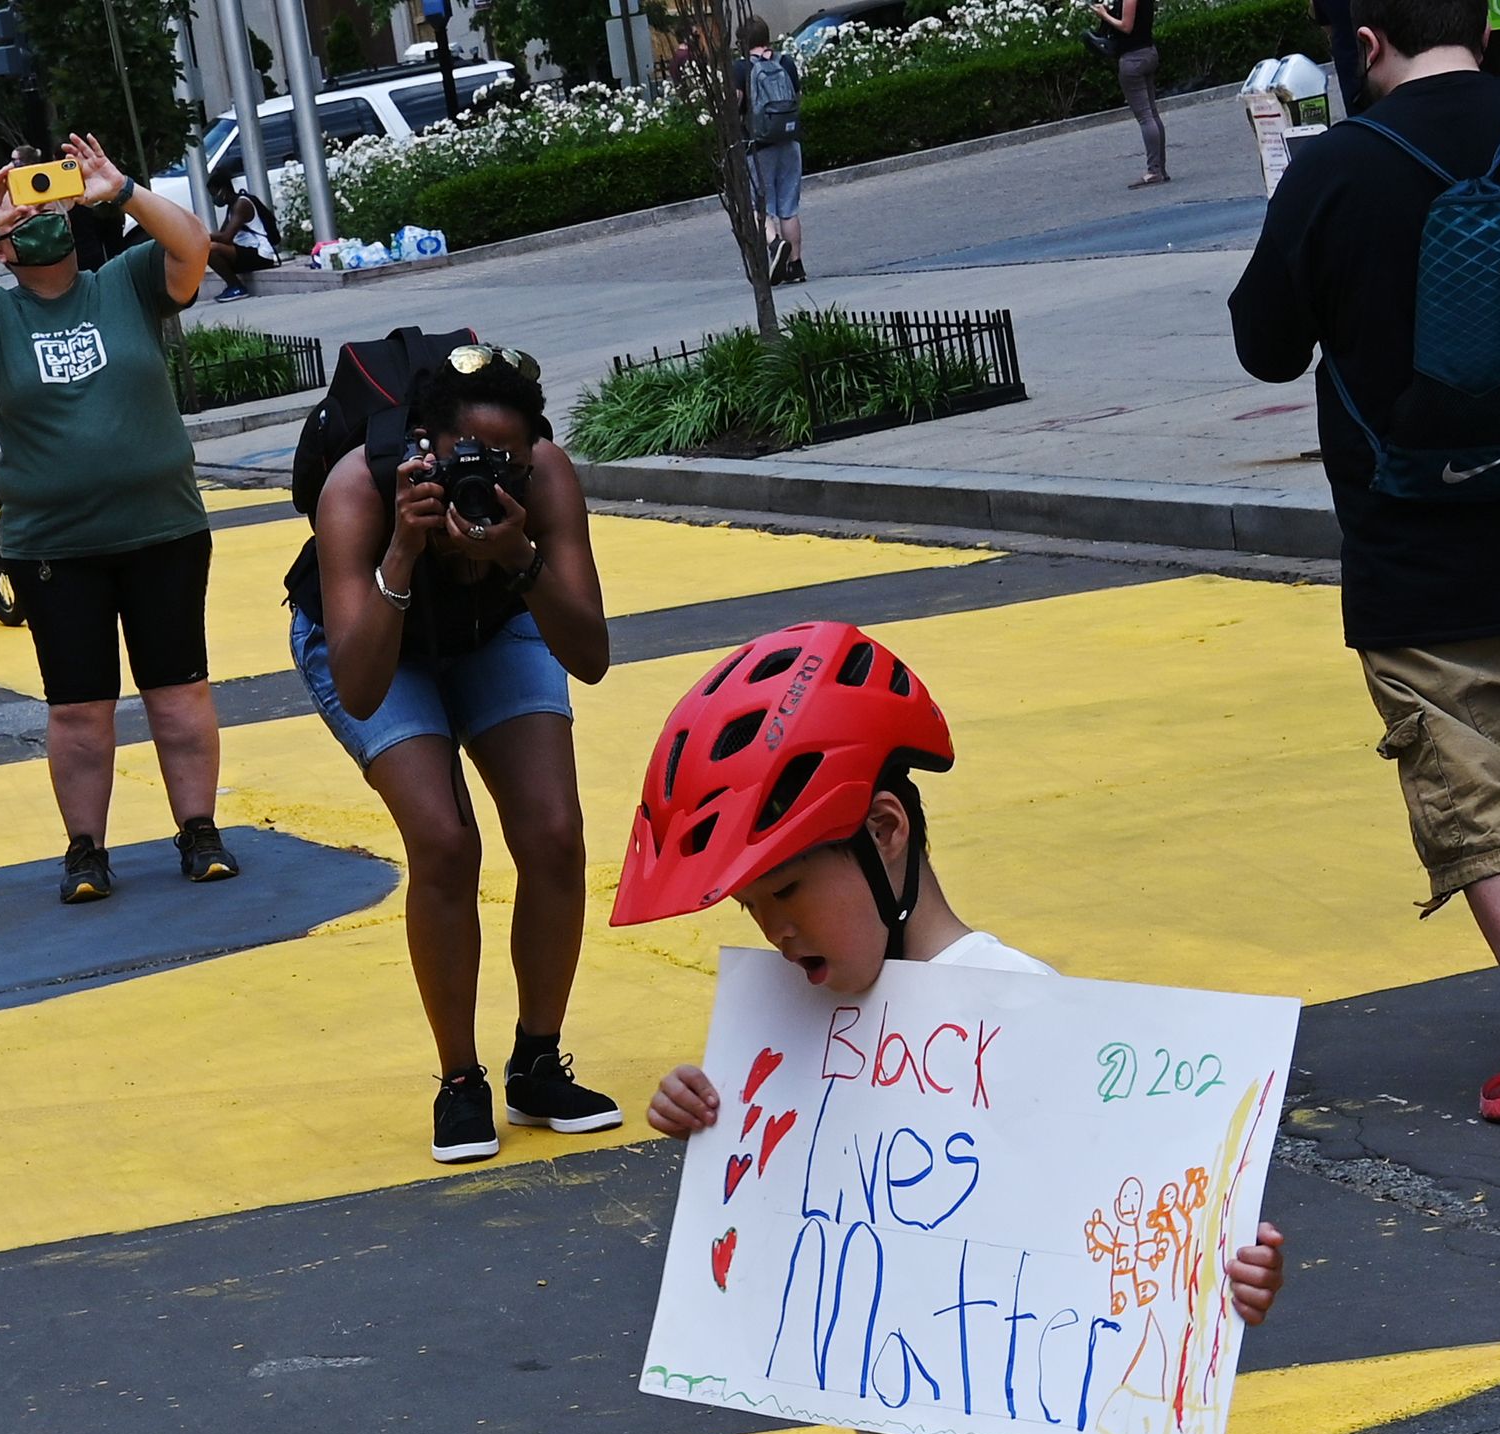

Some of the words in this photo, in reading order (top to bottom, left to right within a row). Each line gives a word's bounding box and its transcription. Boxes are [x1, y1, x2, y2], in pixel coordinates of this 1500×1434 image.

[45, 347, 97, 366] BOISE
[51, 355, 98, 376] FIRST
[779, 655, 824, 716] GIRO
[821, 1000, 1001, 1110] Black
[801, 1073, 980, 1231] Lives
[765, 1218, 1122, 1432] Matter
